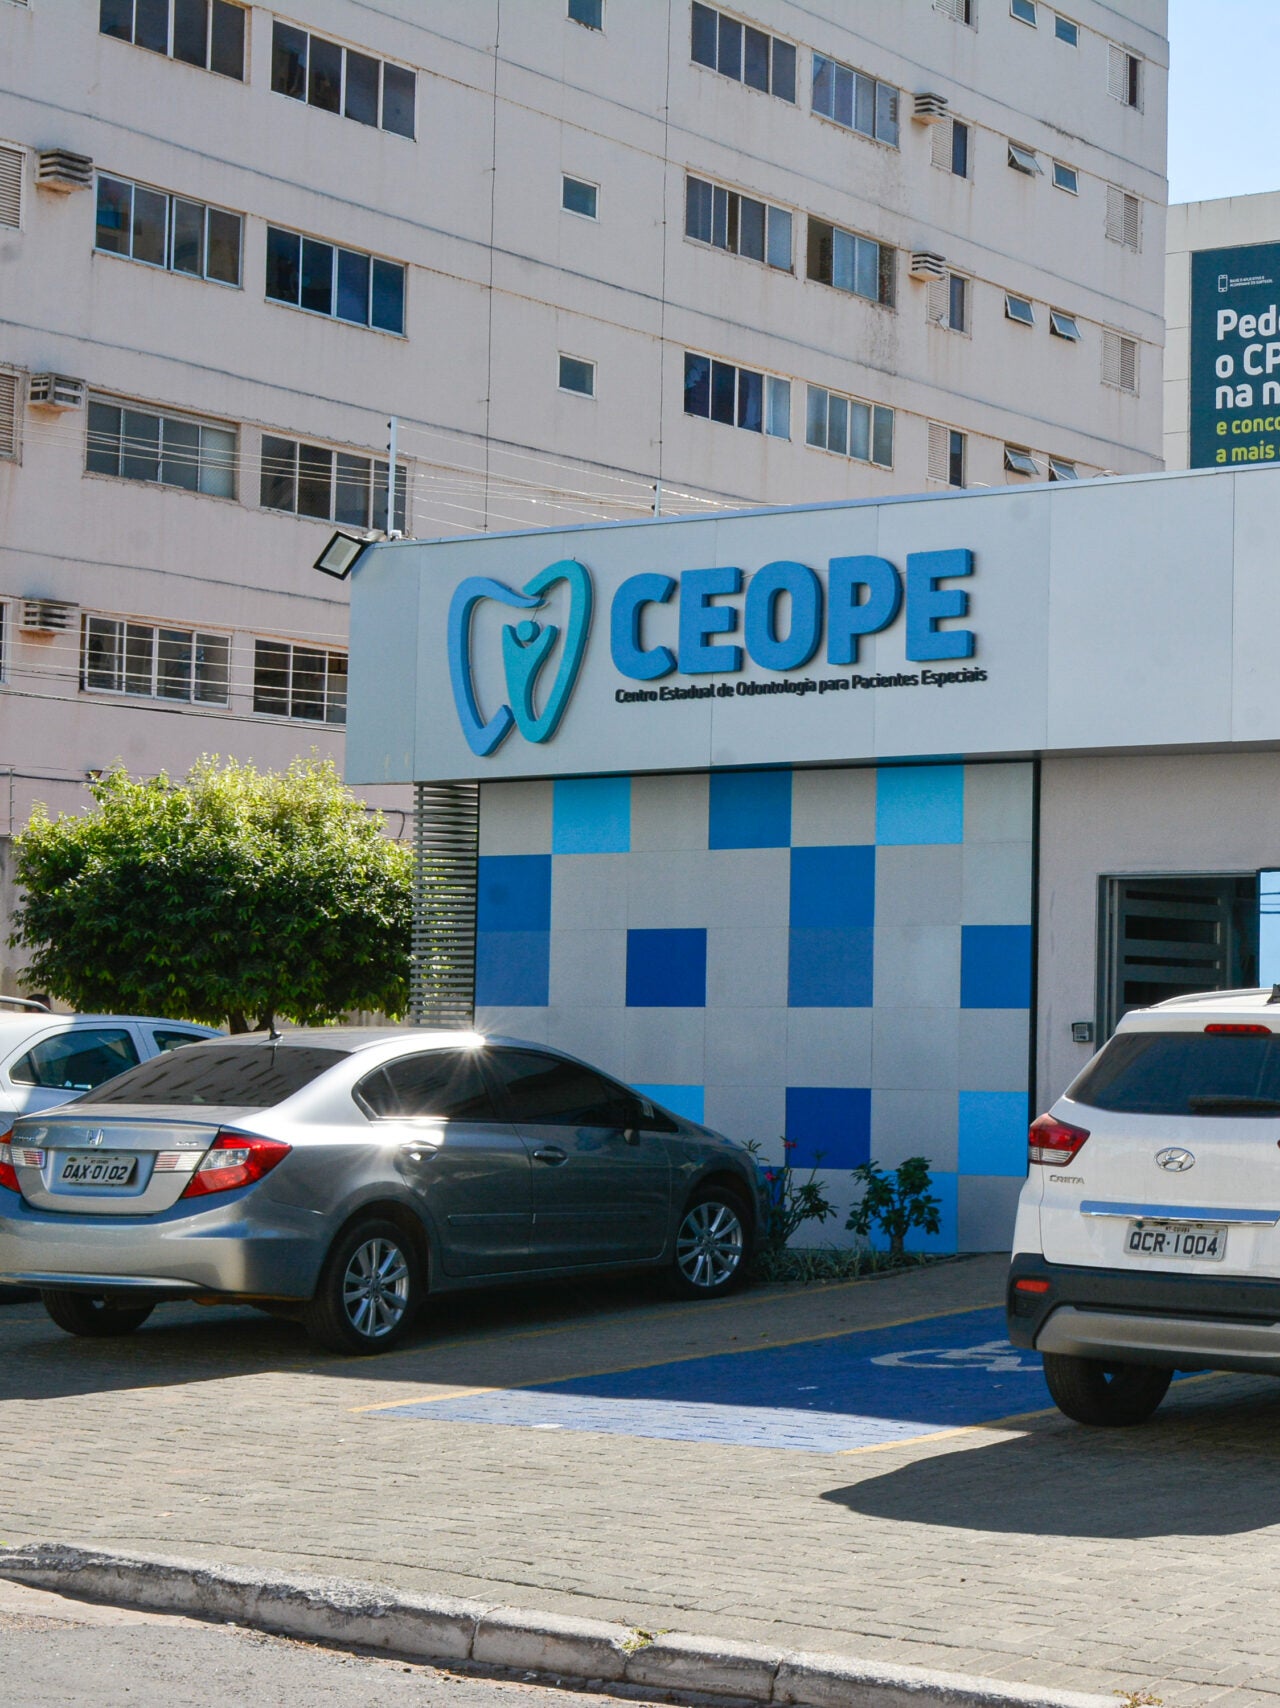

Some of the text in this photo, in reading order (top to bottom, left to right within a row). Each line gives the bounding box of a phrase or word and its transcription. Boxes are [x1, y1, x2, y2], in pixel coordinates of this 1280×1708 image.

[1216, 355, 1234, 378] o
[1216, 383, 1252, 409] na
[1216, 421, 1227, 435] e
[1216, 448, 1226, 463] a
[1232, 440, 1275, 461] mais
[610, 548, 976, 680] CEOPE
[615, 667, 988, 703] Centro Estadual de Odontologia para Pacientes Especiais
